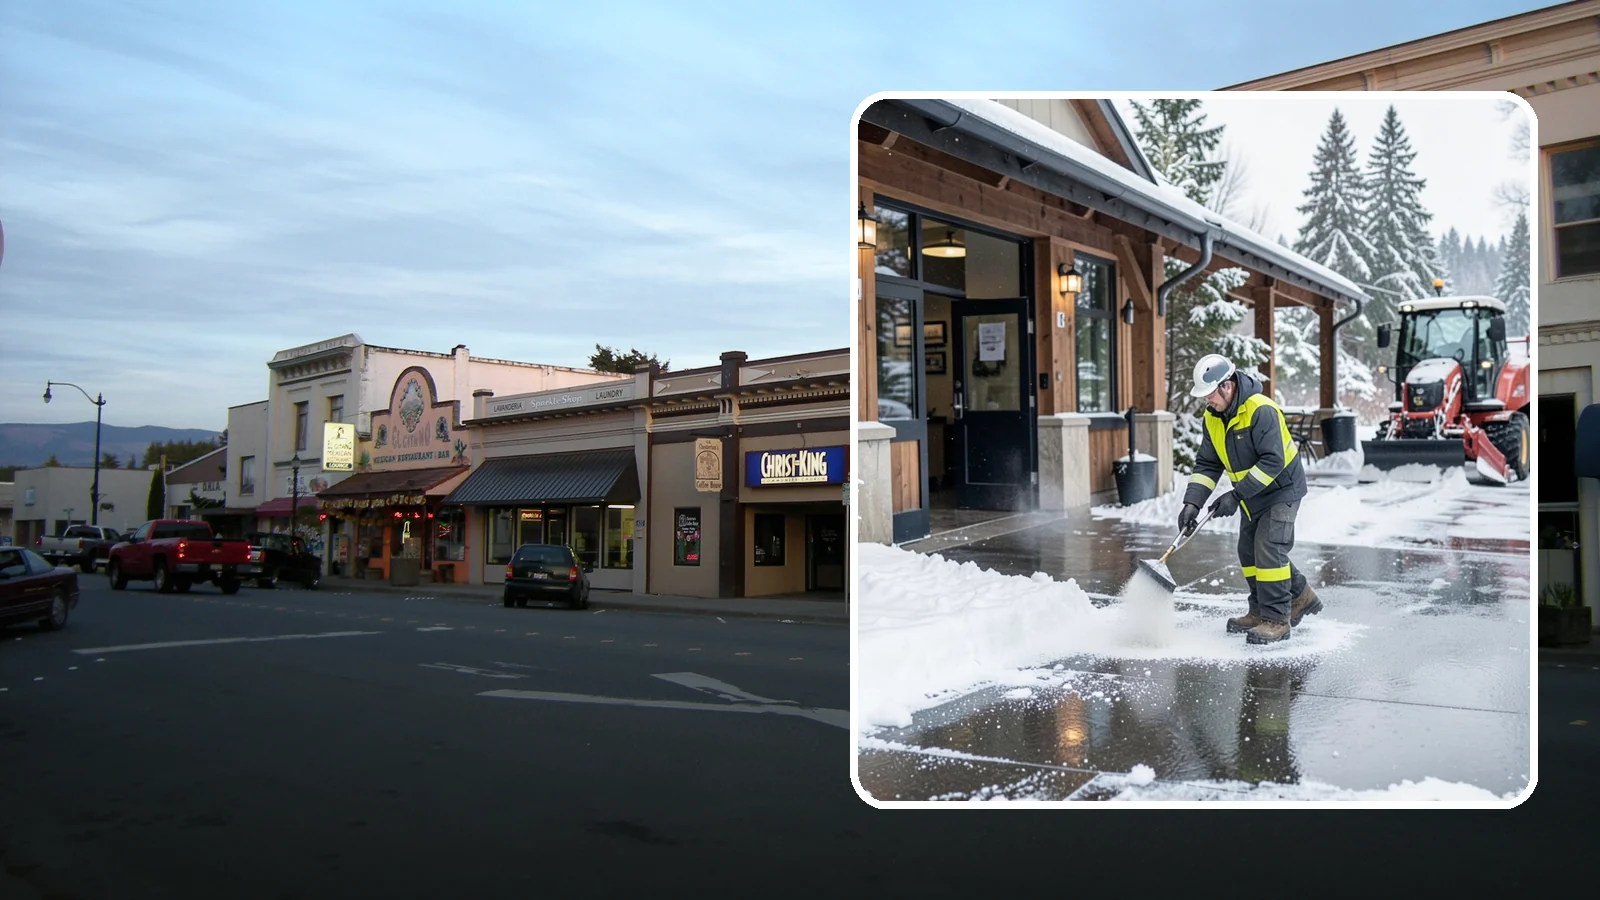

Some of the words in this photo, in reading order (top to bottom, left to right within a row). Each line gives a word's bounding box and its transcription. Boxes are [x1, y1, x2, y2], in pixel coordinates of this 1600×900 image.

[493, 402, 522, 413] LAVANDERIA
[596, 389, 623, 400] LAUNDRY
[373, 454, 396, 463] MEXICAN
[397, 451, 433, 462] RESTAURANT
[438, 450, 450, 458] BAR
[761, 452, 797, 478] CHRIST
[799, 450, 827, 476] KING
